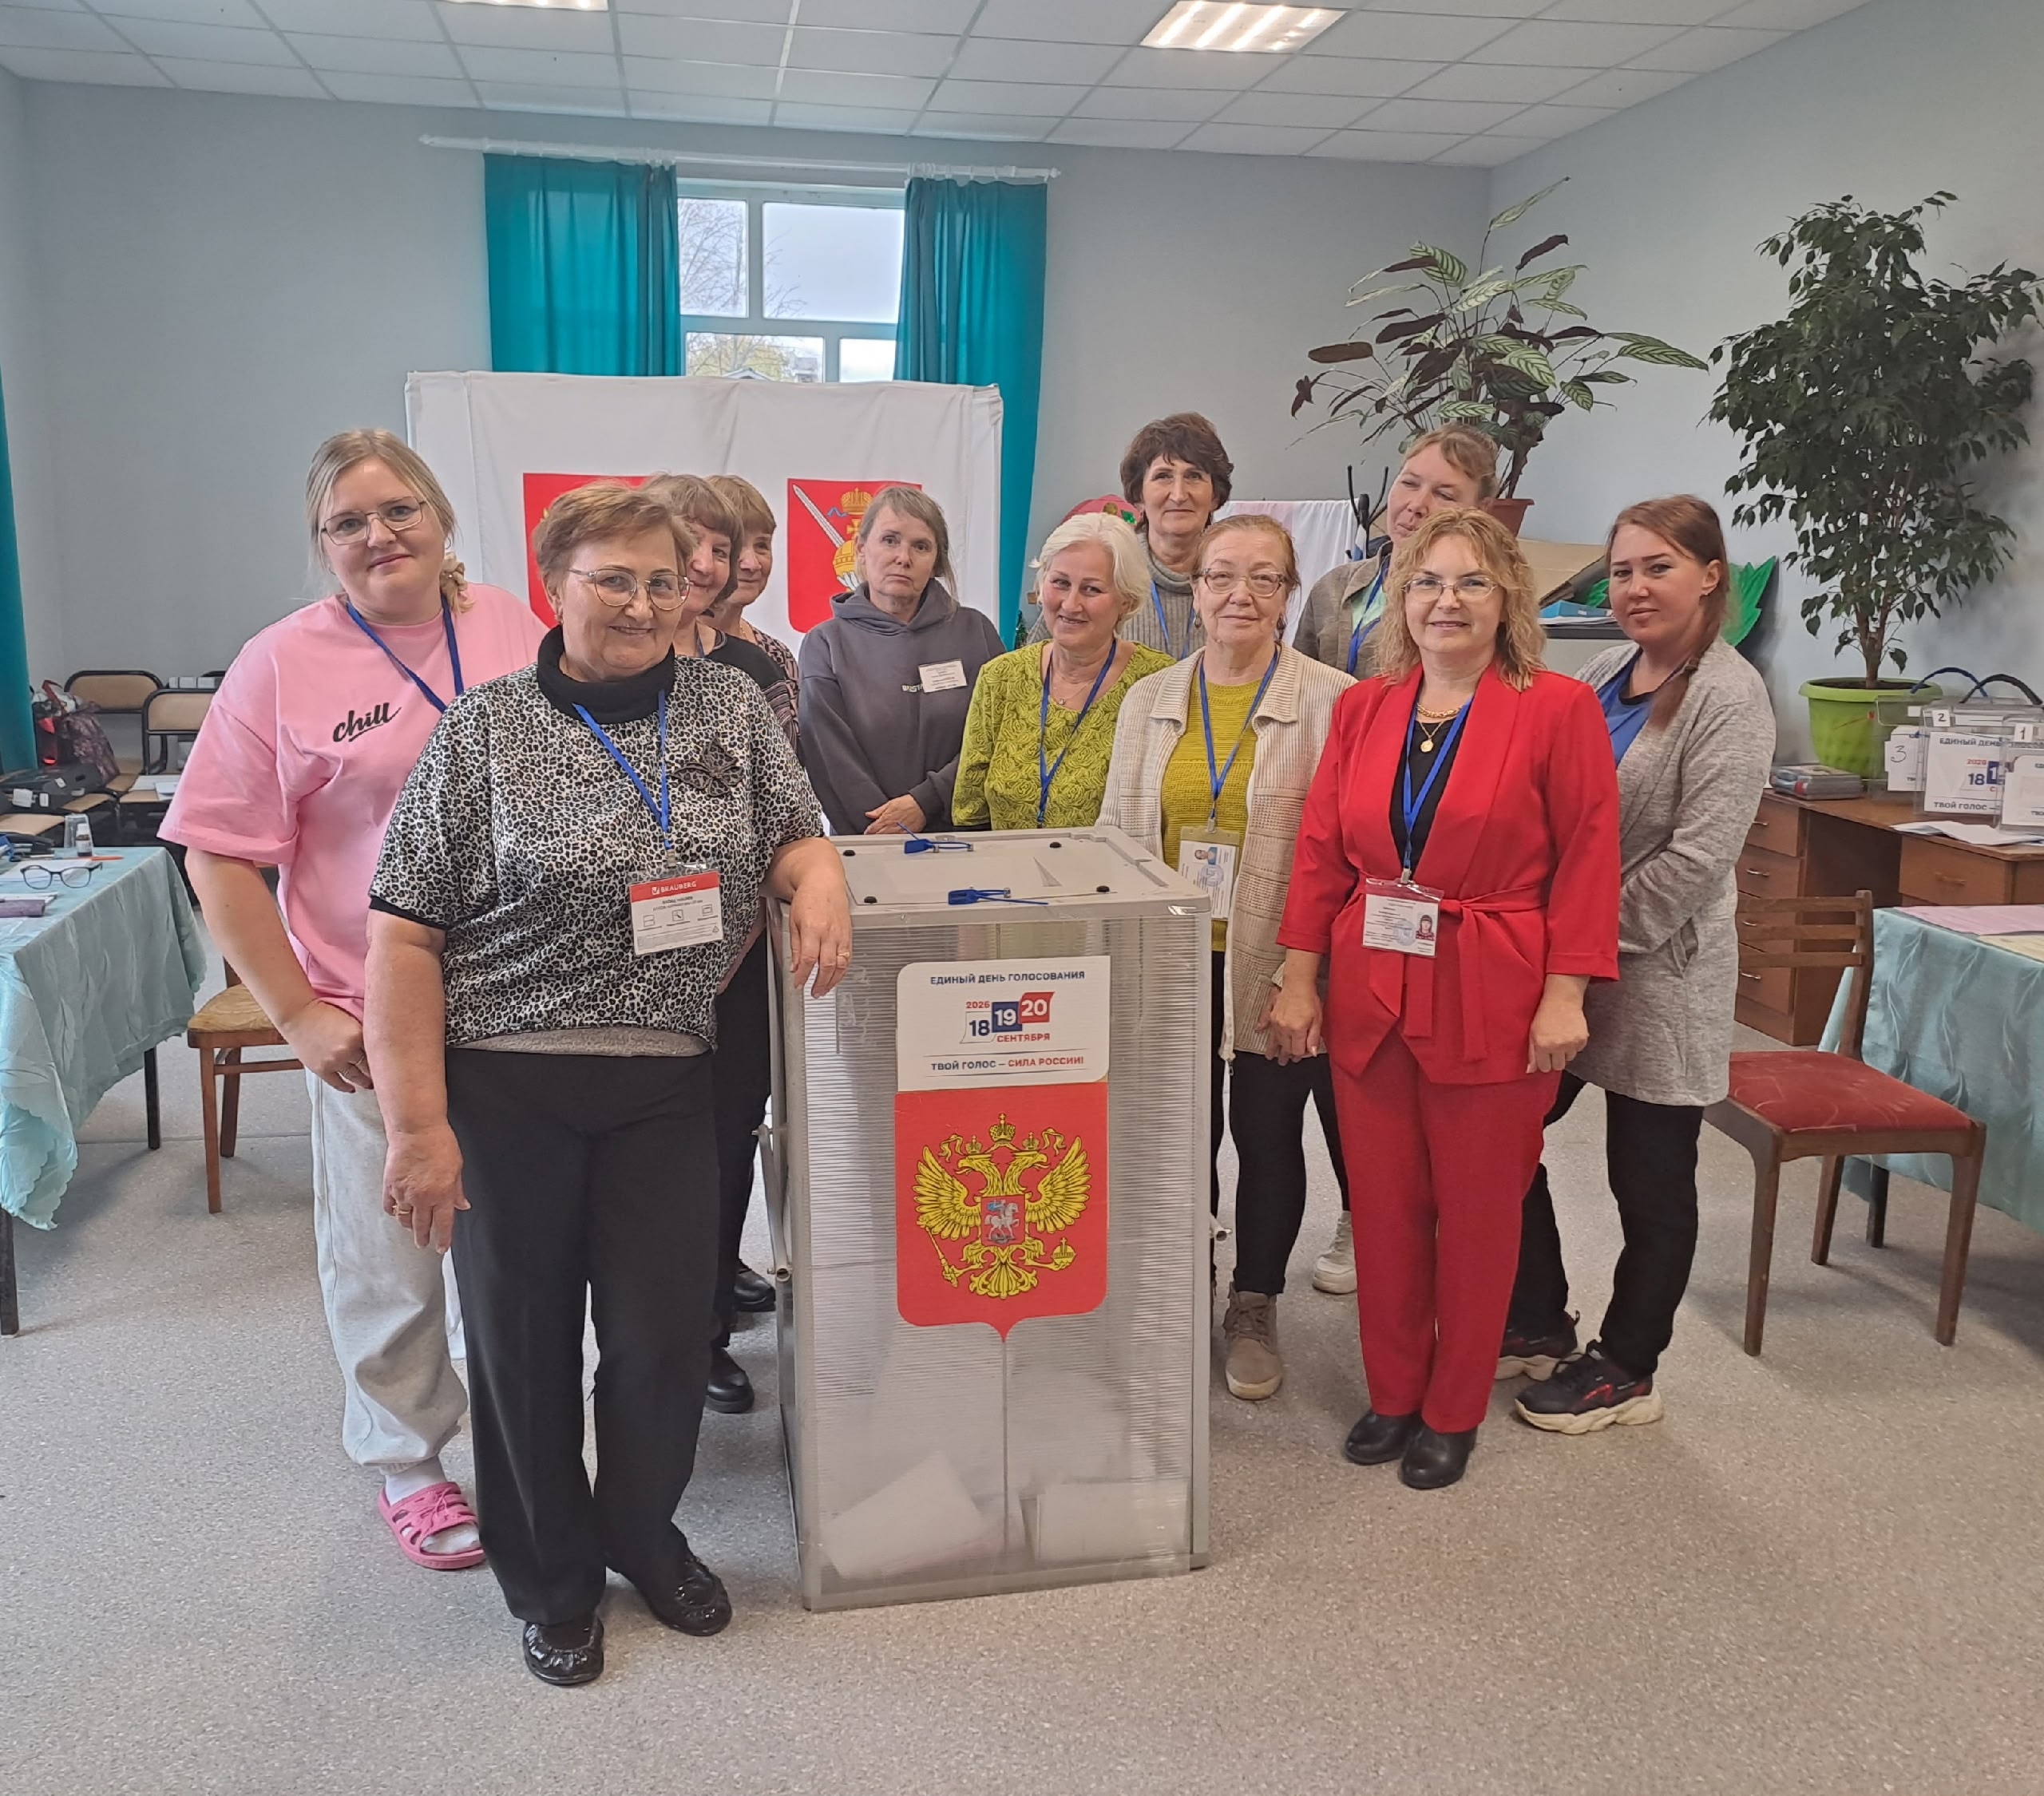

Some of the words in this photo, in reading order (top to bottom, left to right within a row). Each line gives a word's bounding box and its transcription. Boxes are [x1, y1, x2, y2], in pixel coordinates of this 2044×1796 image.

[332, 702, 401, 742] chill
[1938, 713, 1947, 722] 2
[2020, 726, 2026, 741] 1
[1891, 745, 1907, 763] 3
[1968, 773, 1986, 785] 18
[1934, 801, 1957, 809] ТВОЙ
[660, 881, 697, 892] BRAUBERG
[930, 974, 976, 985] ЕДИНЫЙ
[978, 973, 1006, 984] ДЕНЬ
[1008, 971, 1085, 983] ГОЛОСОВАНИЯ
[969, 1019, 990, 1037] 18
[994, 1009, 1016, 1027] 19
[1021, 999, 1048, 1017] 20
[996, 1032, 1051, 1043] СЕНТЯБРЯ
[931, 1061, 959, 1071] ТВОЙ
[961, 1060, 996, 1070] ГОЛОС
[1008, 1058, 1036, 1068] СИЛА
[1039, 1055, 1084, 1066] РОССИИ!
